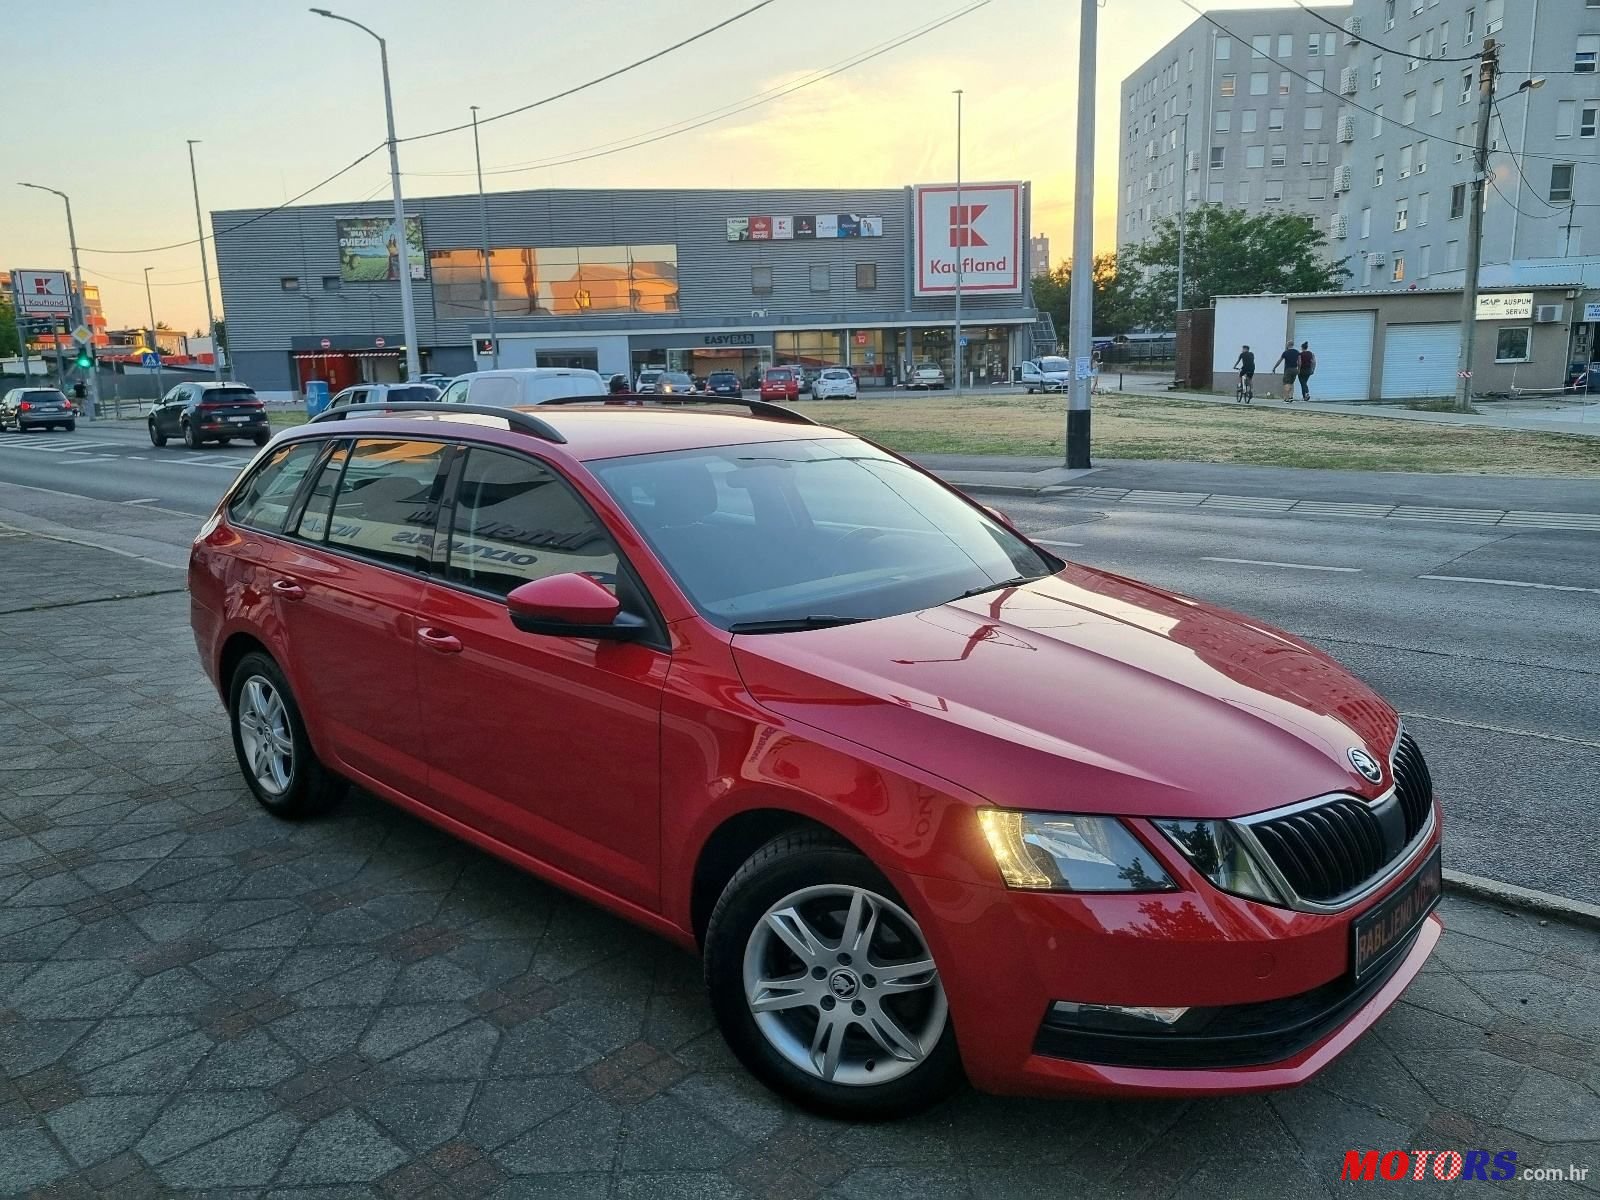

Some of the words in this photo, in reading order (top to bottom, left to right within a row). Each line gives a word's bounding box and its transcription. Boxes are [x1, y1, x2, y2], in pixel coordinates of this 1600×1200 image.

[930, 256, 1006, 274] Kaufland
[1504, 298, 1532, 306] AUSPUH
[1505, 308, 1529, 316] SERVIS
[1359, 895, 1412, 966] RABLJENO
